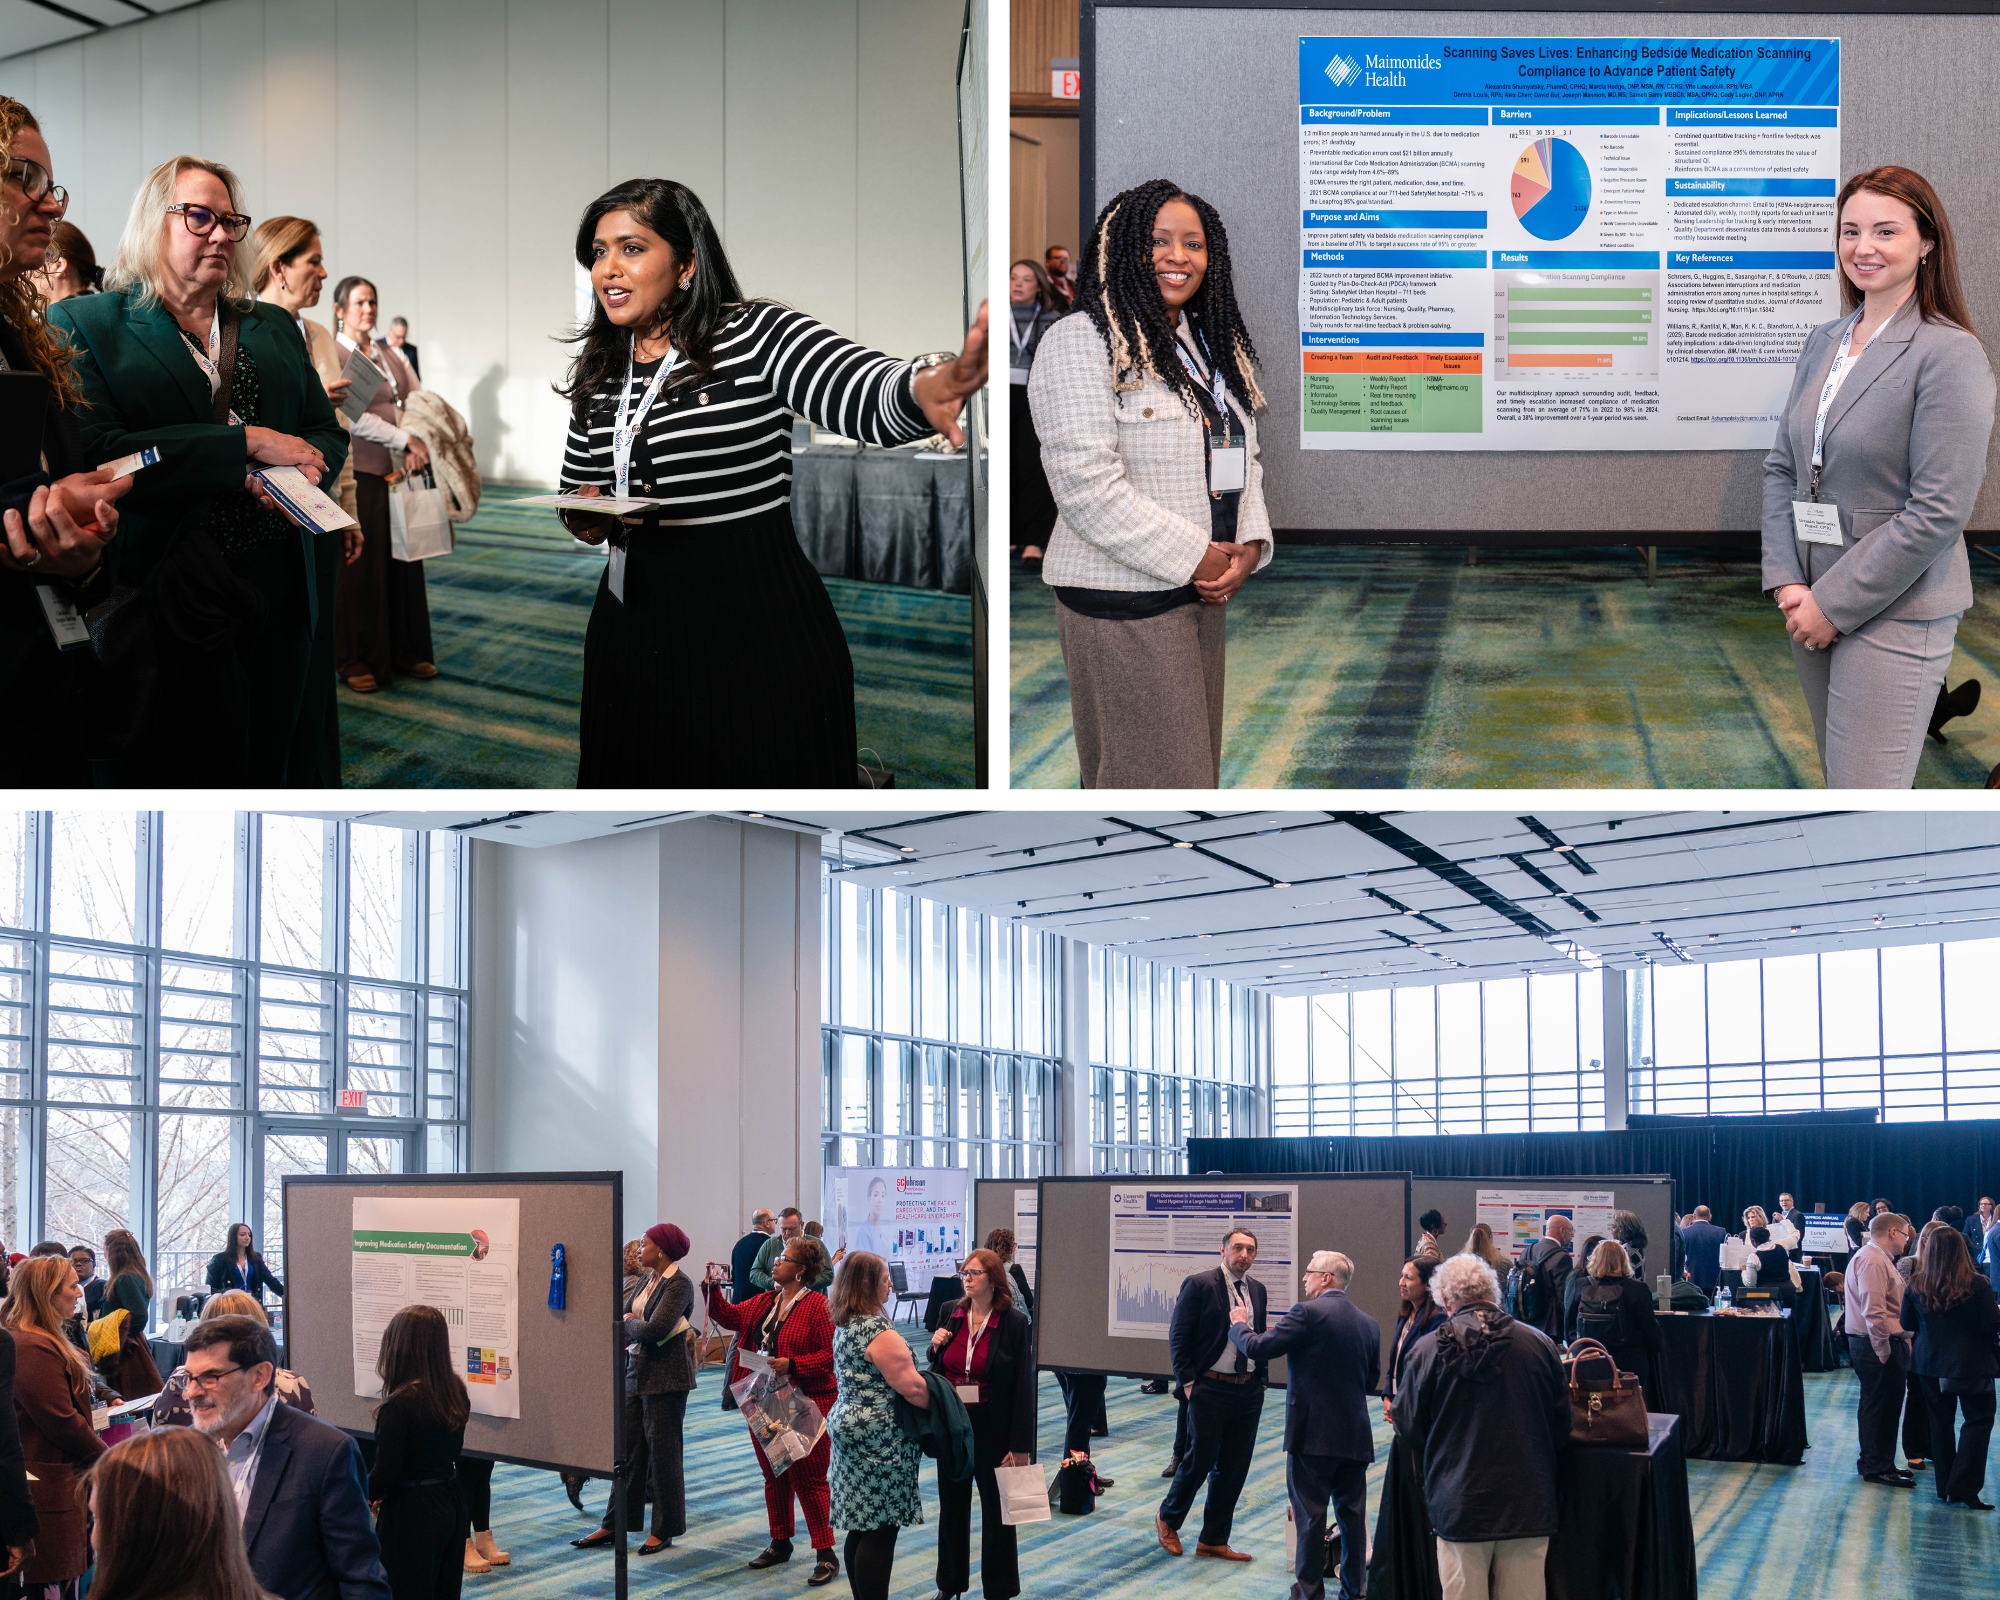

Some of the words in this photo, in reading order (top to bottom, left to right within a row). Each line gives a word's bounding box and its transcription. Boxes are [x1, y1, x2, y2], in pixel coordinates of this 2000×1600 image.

[1444, 46, 1497, 61] Scanning
[1501, 47, 1535, 58] Saves
[1539, 47, 1572, 58] Lives:
[1577, 47, 1637, 61] Enhancing
[1642, 47, 1687, 58] Bedside
[1692, 47, 1753, 59] Medication
[1757, 48, 1811, 62] Scanning
[1366, 54, 1441, 69] Maimonides
[1519, 65, 1586, 79] Compliance
[1589, 66, 1600, 77] to
[1604, 65, 1653, 76] Advance
[1658, 65, 1697, 76] Patient
[1700, 65, 1735, 79] Safety
[1366, 71, 1406, 86] Health
[1064, 73, 1080, 96] EX
[1310, 109, 1390, 119] Background/Problem
[1501, 110, 1532, 118] Barriers
[1676, 111, 1753, 121] Implications/Lessons
[1756, 111, 1787, 119] Learned
[1675, 181, 1725, 191] Sustainability
[1311, 213, 1342, 223] Purpose
[1359, 213, 1379, 221] Aims
[1311, 252, 1344, 260] Methods
[1501, 253, 1528, 261] Results
[1676, 254, 1690, 264] Key
[1692, 254, 1733, 262] References
[1309, 336, 1360, 344] Interventions
[343, 1091, 363, 1107] EXIT
[355, 1240, 378, 1248] Improving
[409, 1241, 425, 1250] Safety
